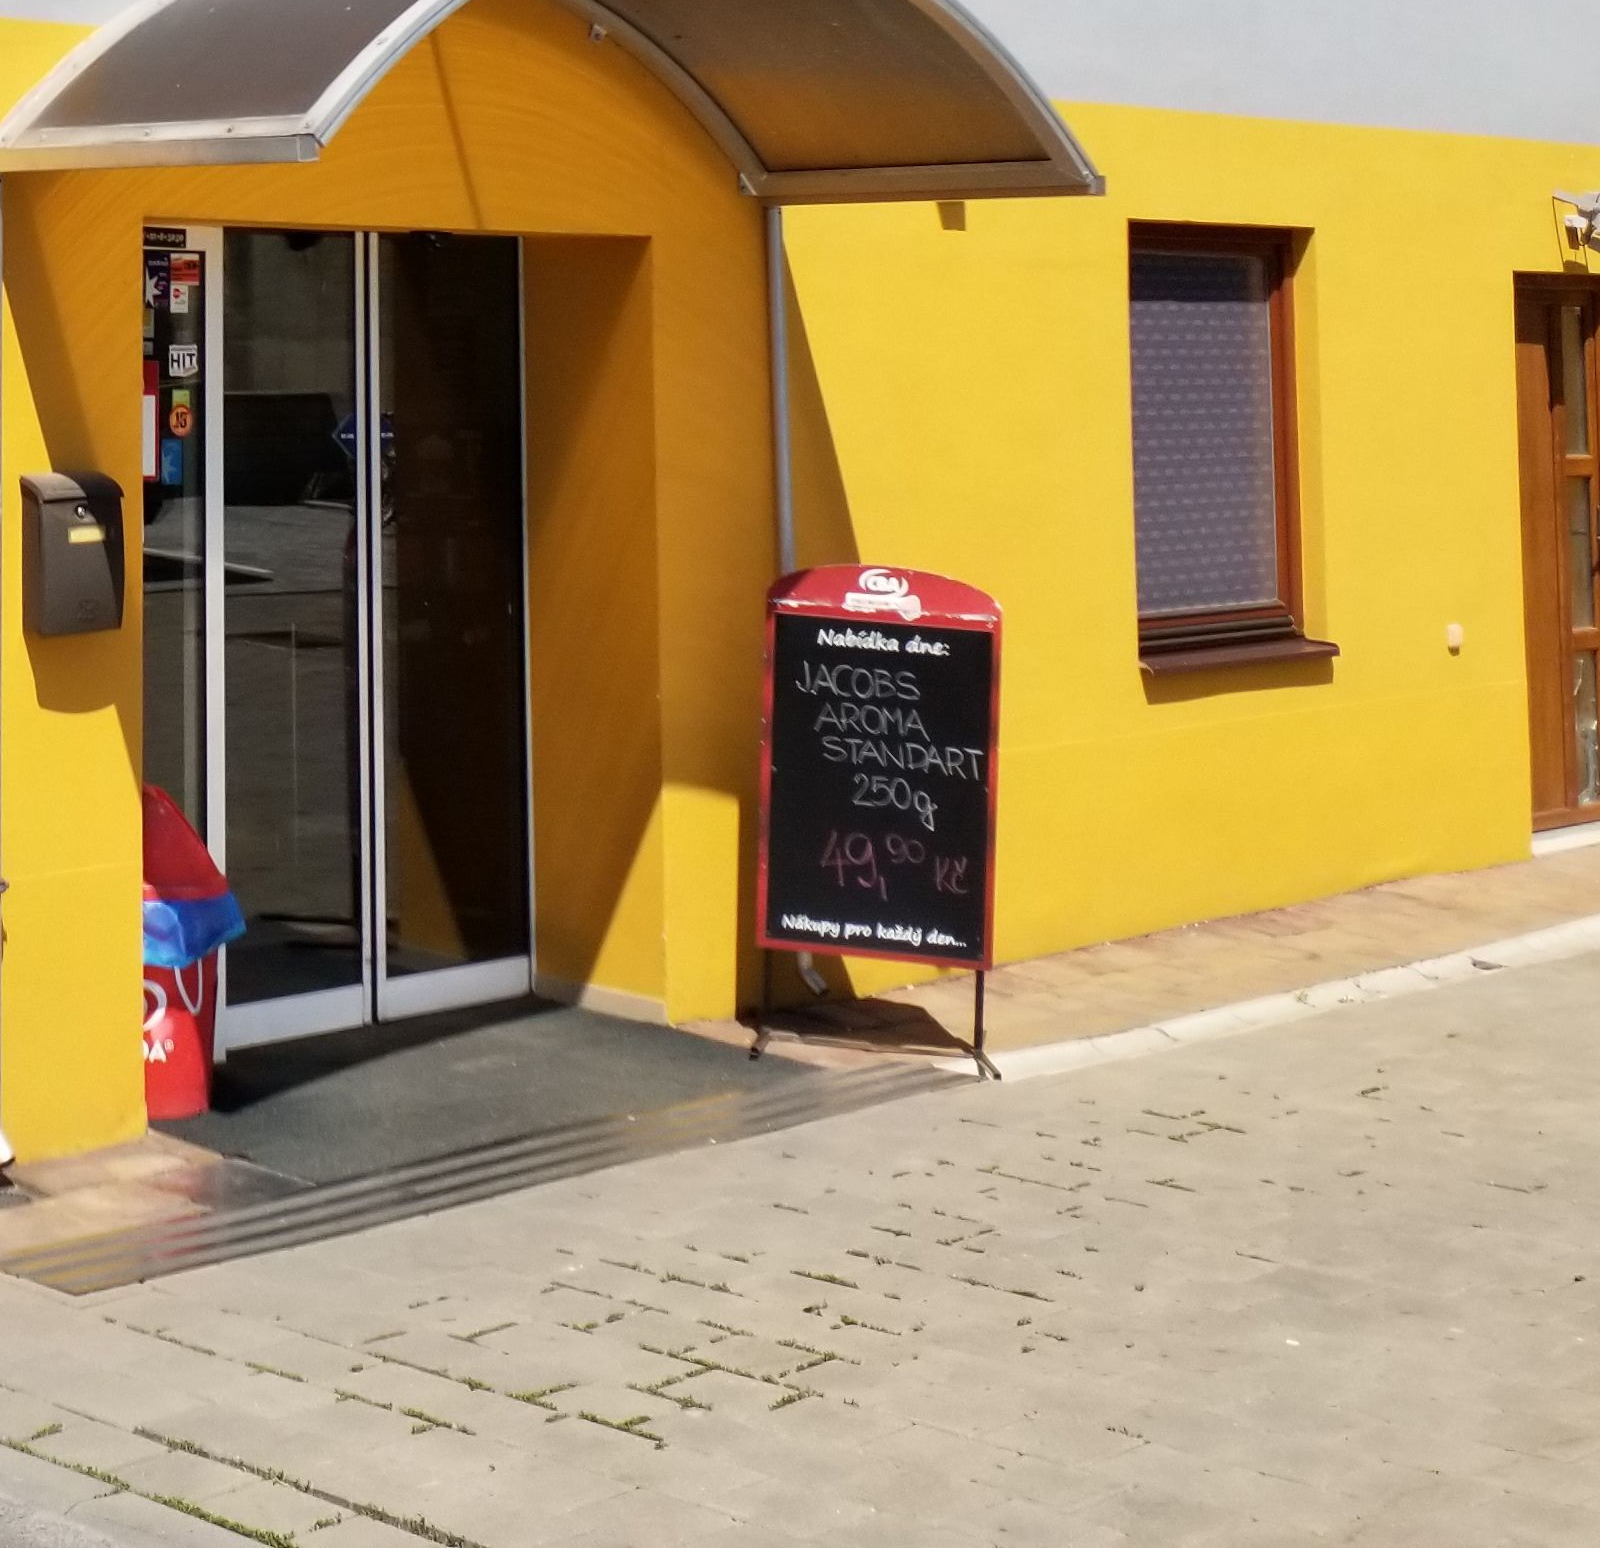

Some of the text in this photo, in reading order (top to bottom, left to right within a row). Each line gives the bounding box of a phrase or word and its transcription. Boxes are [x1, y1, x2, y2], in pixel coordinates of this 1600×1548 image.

[170, 352, 196, 370] HIT
[817, 627, 900, 653] Nabídka
[795, 660, 921, 700] JACOBS
[813, 702, 931, 742] AROMA
[822, 735, 984, 781] STANDART
[852, 772, 939, 832] 250g
[781, 913, 841, 939] Nákupy
[843, 922, 873, 940] pro
[876, 921, 923, 948] každý
